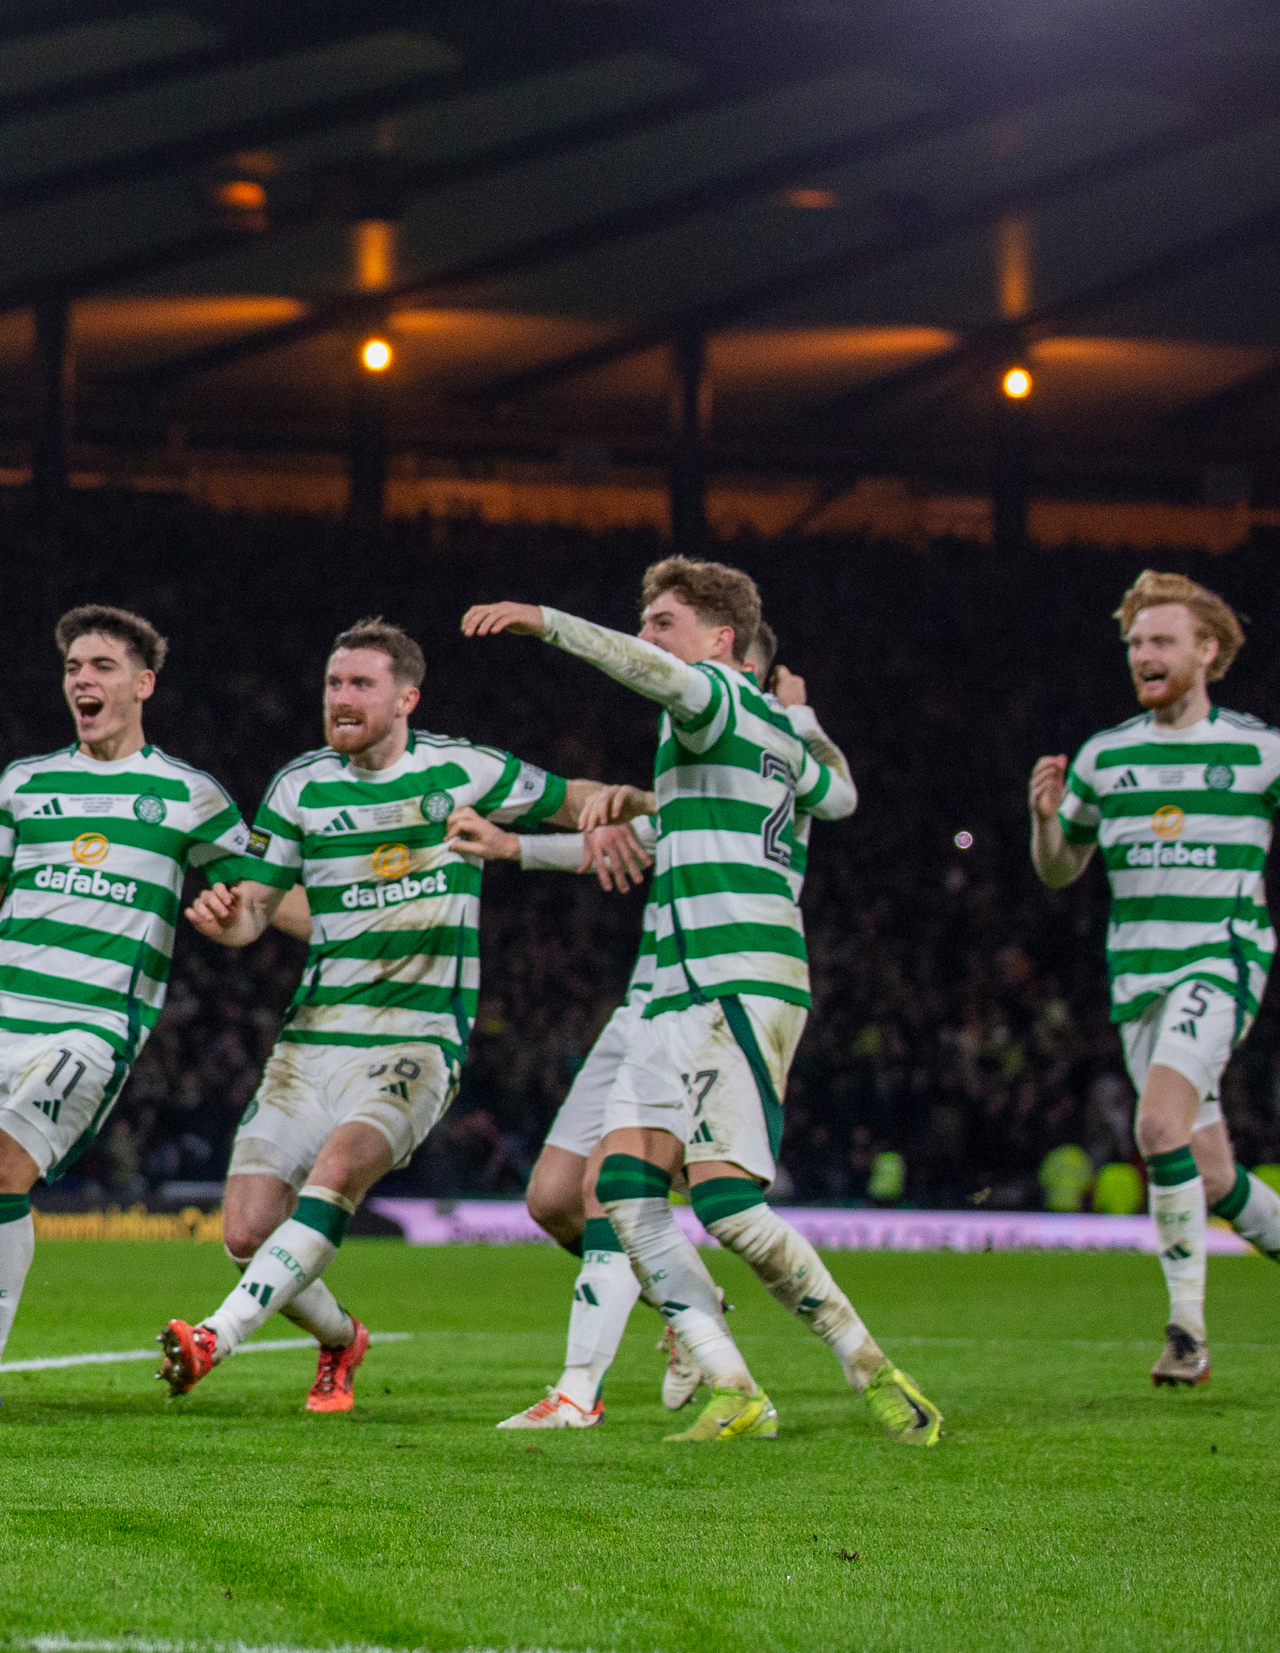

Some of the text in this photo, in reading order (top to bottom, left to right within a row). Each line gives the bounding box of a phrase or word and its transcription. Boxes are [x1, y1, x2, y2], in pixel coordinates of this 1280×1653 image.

[1126, 840, 1217, 868] dafabet
[34, 864, 138, 903] dafabet
[341, 869, 448, 909] dafabet
[1181, 981, 1216, 1017] 5
[45, 1048, 87, 1099] 11
